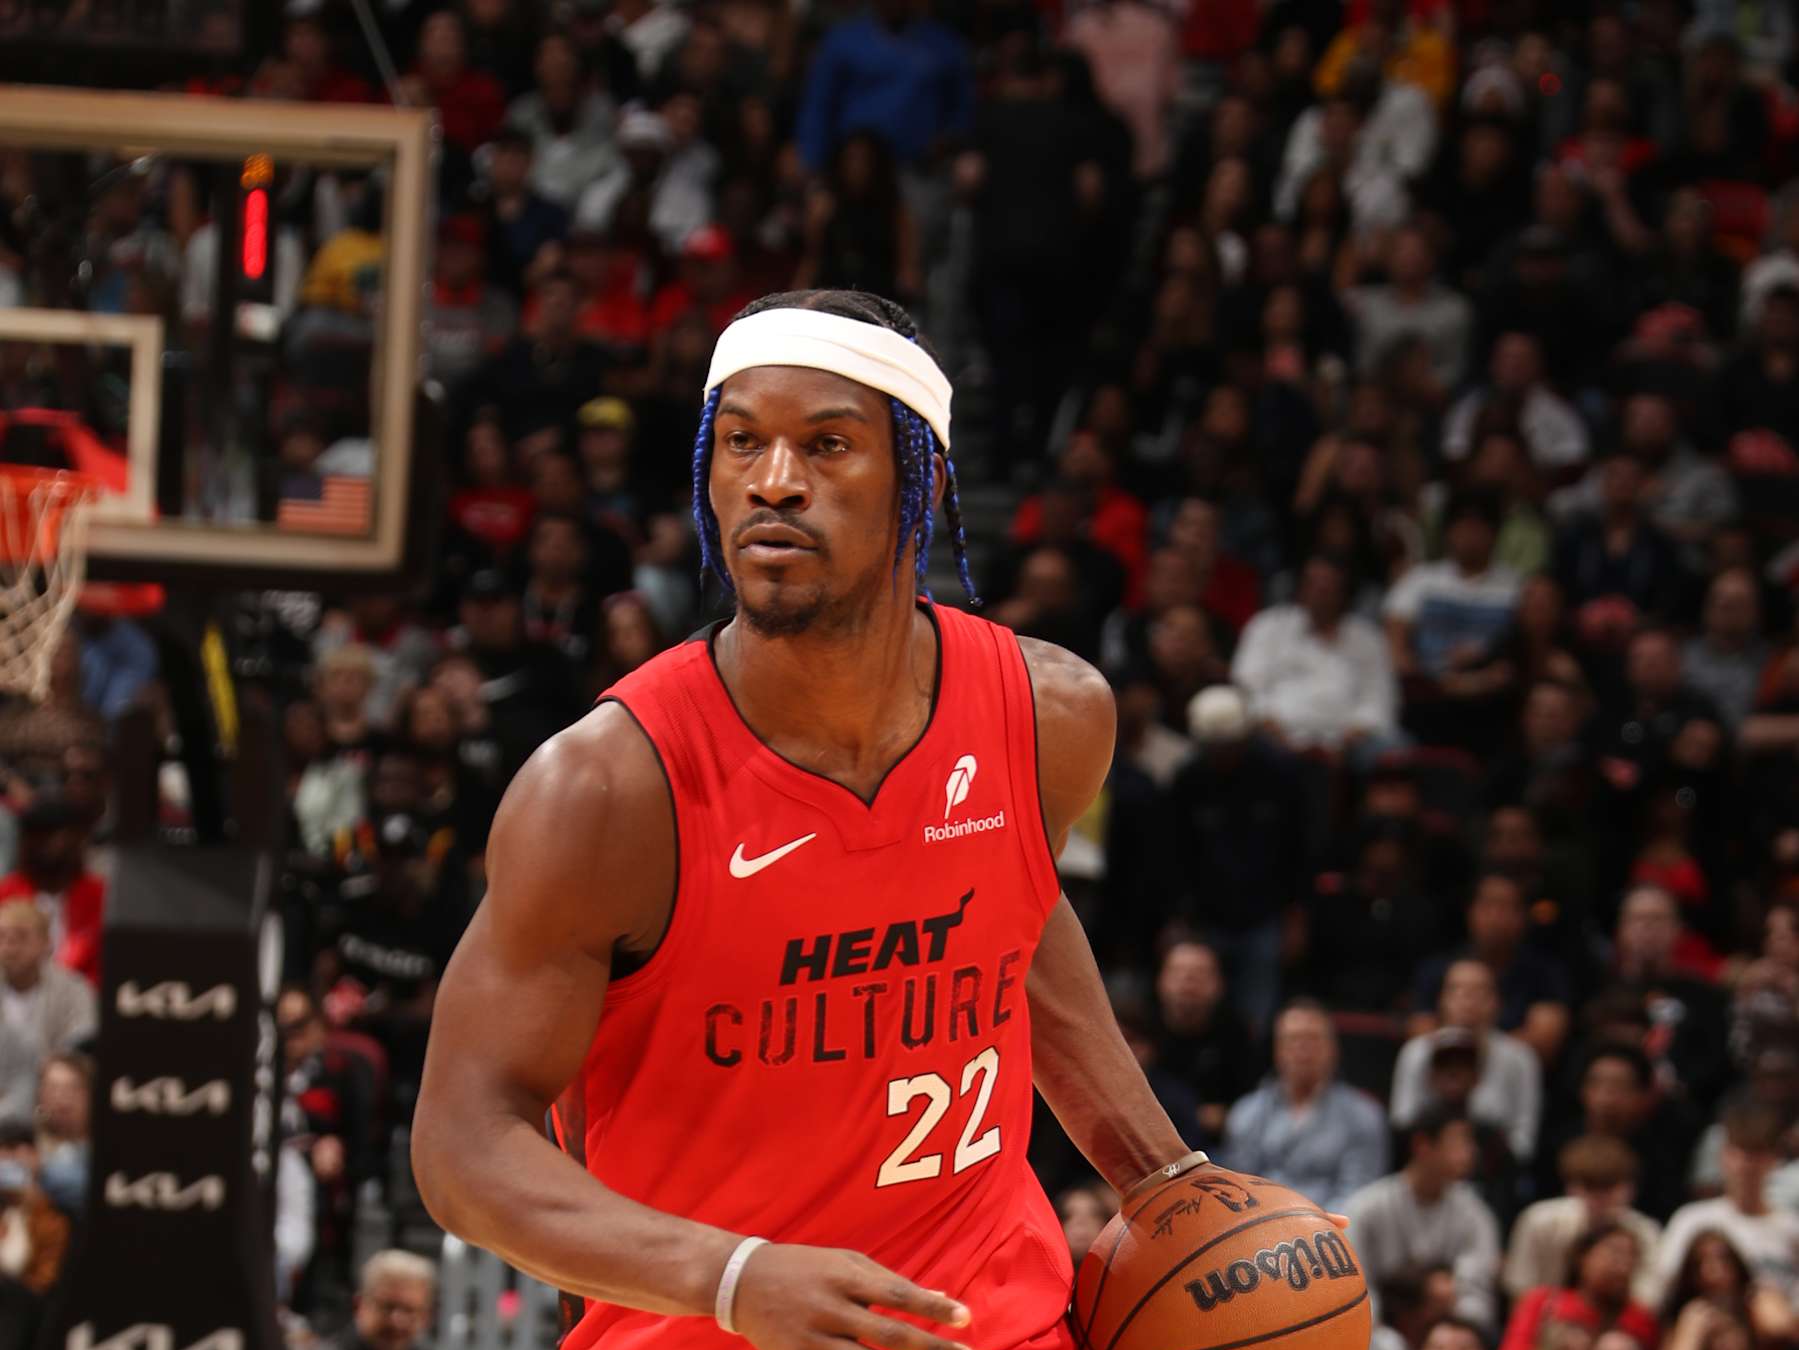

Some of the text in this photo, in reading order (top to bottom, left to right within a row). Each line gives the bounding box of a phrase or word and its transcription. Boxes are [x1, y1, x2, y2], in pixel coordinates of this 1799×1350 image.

[923, 811, 1005, 843] Robinhood
[779, 888, 975, 986] HEAT
[703, 949, 1022, 1068] CULTURE
[876, 1046, 1003, 1189] 22
[1184, 1230, 1358, 1311] Wilson
